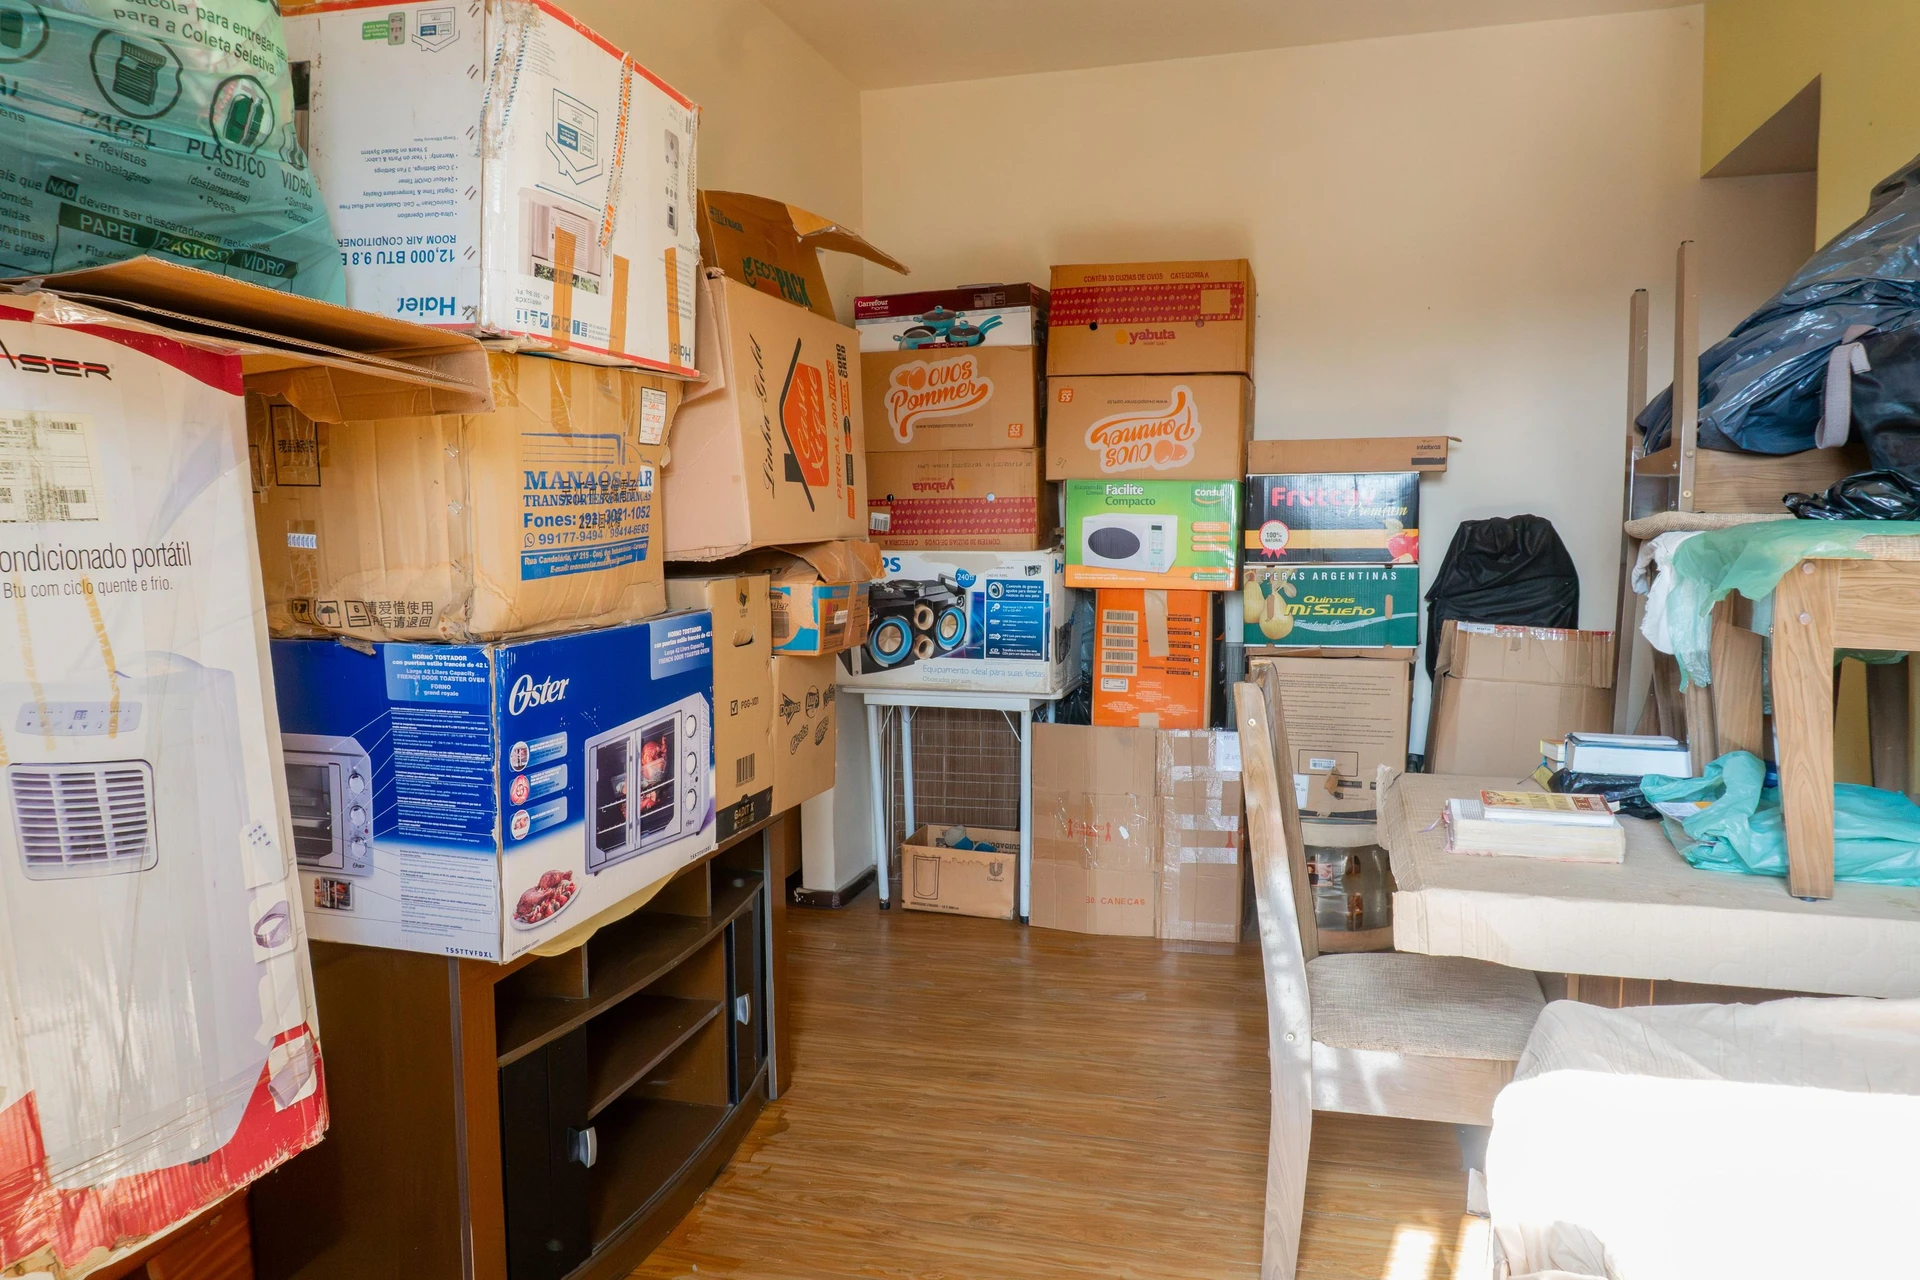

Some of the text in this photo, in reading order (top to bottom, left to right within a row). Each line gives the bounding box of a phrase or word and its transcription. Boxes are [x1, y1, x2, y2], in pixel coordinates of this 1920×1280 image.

[196, 7, 228, 30] para
[233, 20, 274, 51] entregar
[113, 8, 277, 75] para a Coleta Seletiva.
[81, 108, 156, 146] PAPEL
[99, 142, 147, 167] Revistas
[361, 148, 380, 156] System
[214, 168, 249, 188] Garrafas
[282, 169, 311, 198] VIDRO
[20, 176, 42, 191] que
[78, 194, 120, 215] devem
[123, 208, 142, 221] ser
[188, 175, 250, 204] (destampadas)
[383, 189, 416, 197] Temperature
[207, 195, 236, 214] Peças
[80, 214, 139, 245] PAPEL
[337, 235, 456, 248] ROOM AIR CONDITIONER
[243, 253, 285, 276] VIDRO
[352, 247, 455, 265] 12,000 BTU 9.8
[1108, 273, 1115, 282] 30
[1138, 273, 1146, 281] DE
[1147, 272, 1164, 280] OVOS
[1170, 272, 1204, 280] CATEGORIA
[397, 297, 456, 316] Haier
[858, 299, 888, 308] Carrefour
[1129, 328, 1176, 345] yabuta
[668, 341, 691, 363] Haier
[749, 333, 768, 402] Gold
[890, 380, 988, 424] Pommer
[1061, 393, 1071, 402] 55
[796, 378, 811, 459] Casa
[830, 402, 839, 429] 200
[1010, 425, 1020, 433] 55
[1091, 405, 1195, 447] Pommer
[762, 413, 776, 499] Linha
[833, 432, 843, 500] PERCAL
[524, 465, 622, 490] MANAÓS
[912, 478, 955, 493] yabuta
[1106, 484, 1144, 495] Facilite
[1105, 496, 1156, 508] Compacto
[524, 512, 576, 528] Fones:
[538, 530, 603, 544] 99177-9494
[133, 541, 193, 574] portátil
[524, 557, 537, 565] Rua
[1265, 571, 1397, 581] PERAS ARGENTINAS
[3, 575, 173, 600] Btu com ciclo quente e frio.
[922, 665, 1045, 678] Equipamento ideal para suas festas
[509, 674, 569, 716] Oster
[1085, 896, 1146, 906] 30 CANECAS
[445, 946, 493, 958] TSSTTVFDXL
